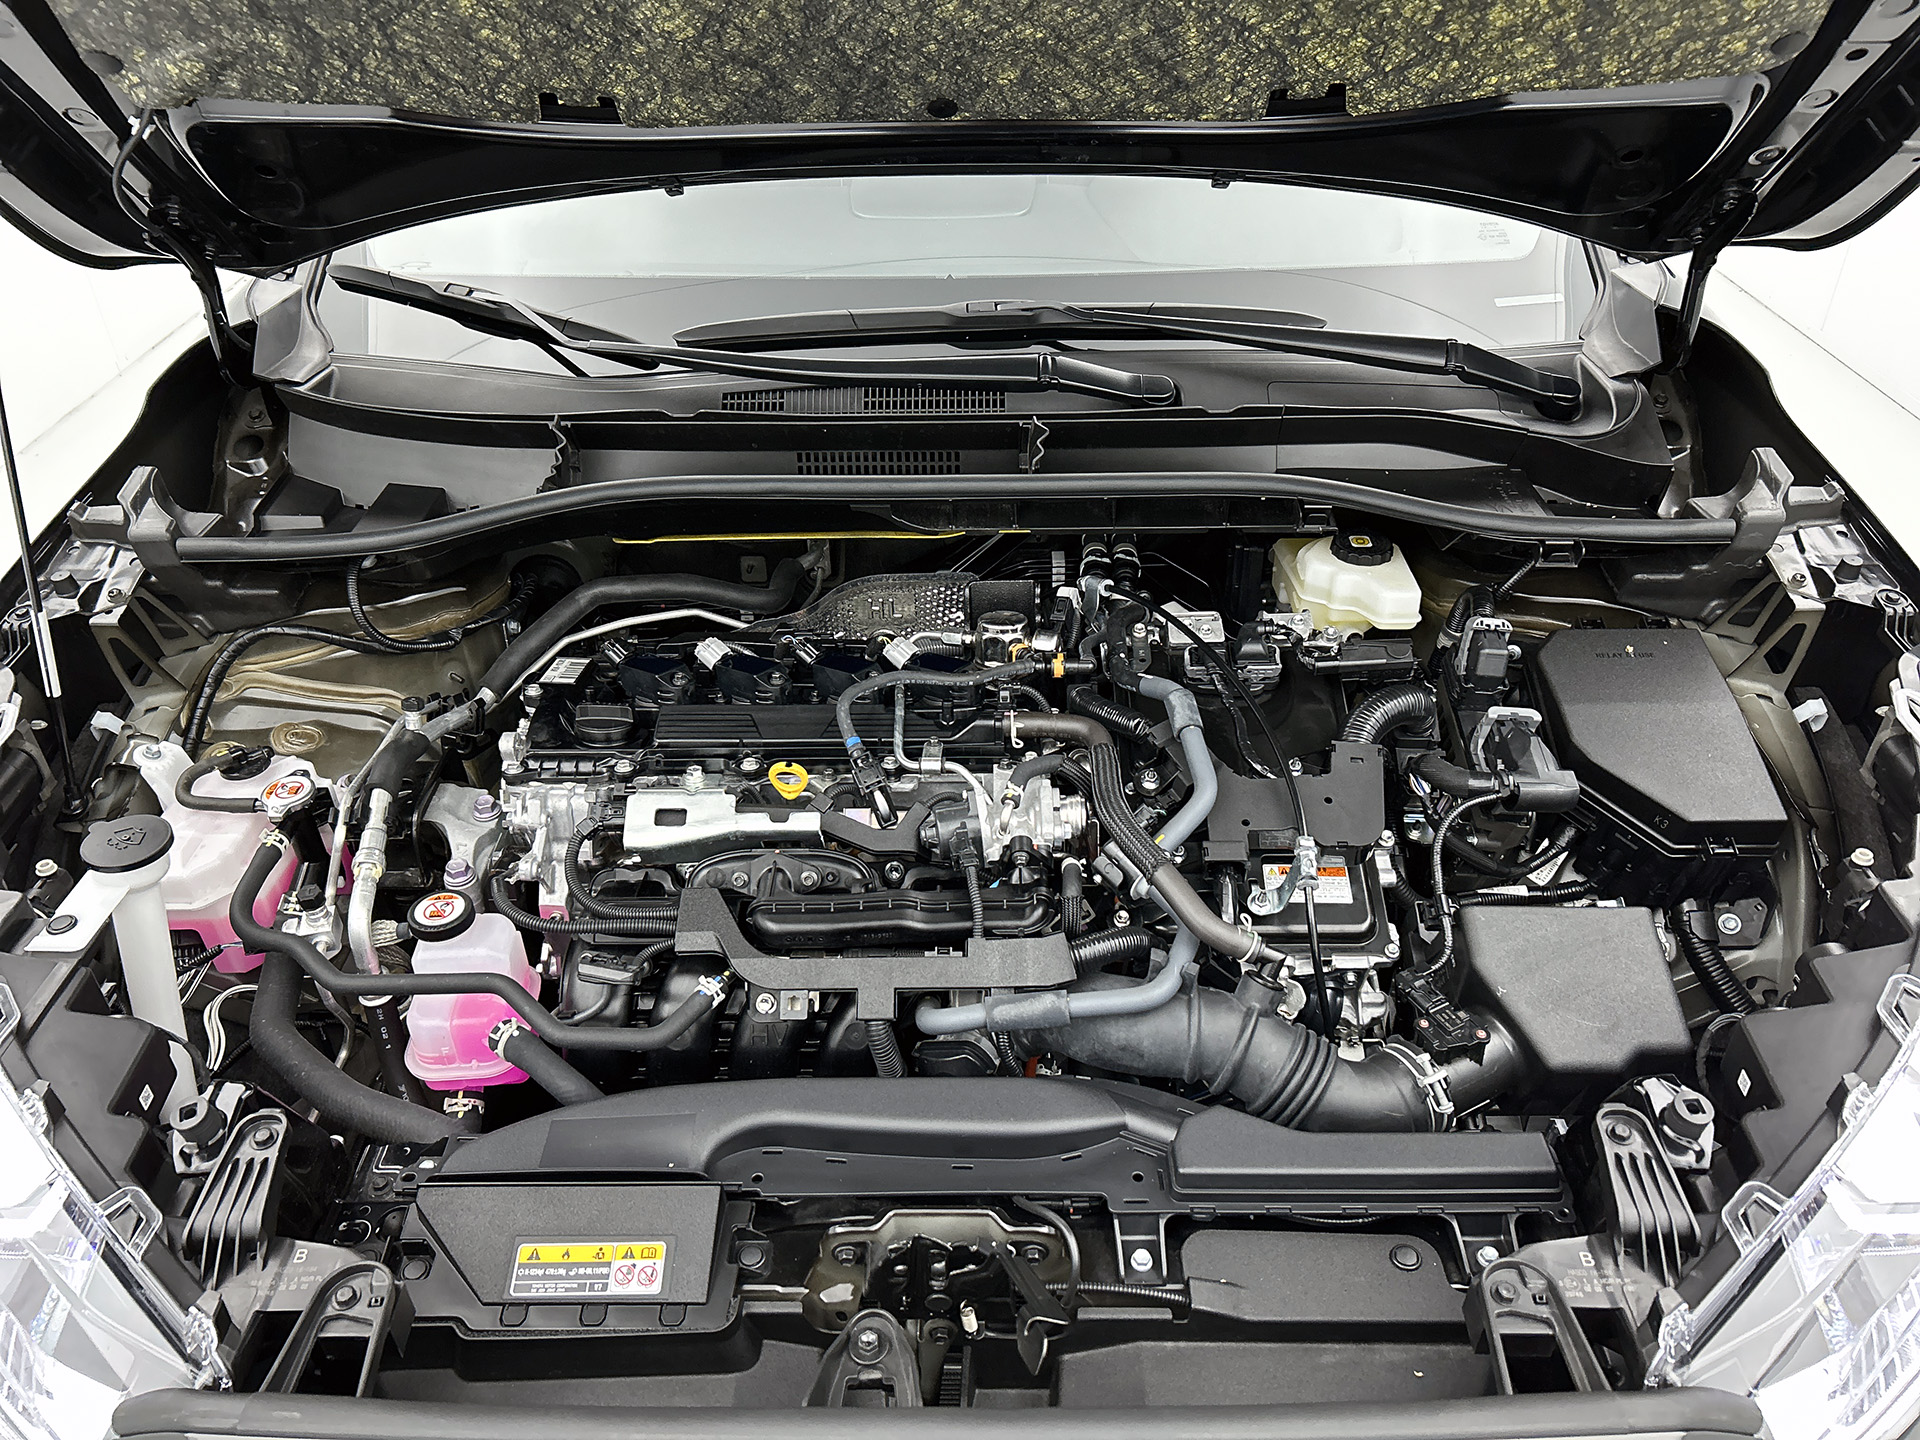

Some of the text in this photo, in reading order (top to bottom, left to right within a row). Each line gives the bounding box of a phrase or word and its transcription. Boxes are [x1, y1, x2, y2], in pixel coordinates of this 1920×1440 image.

[1653, 814, 1670, 829] K3
[293, 1248, 309, 1264] B
[1578, 1251, 1596, 1267] B
